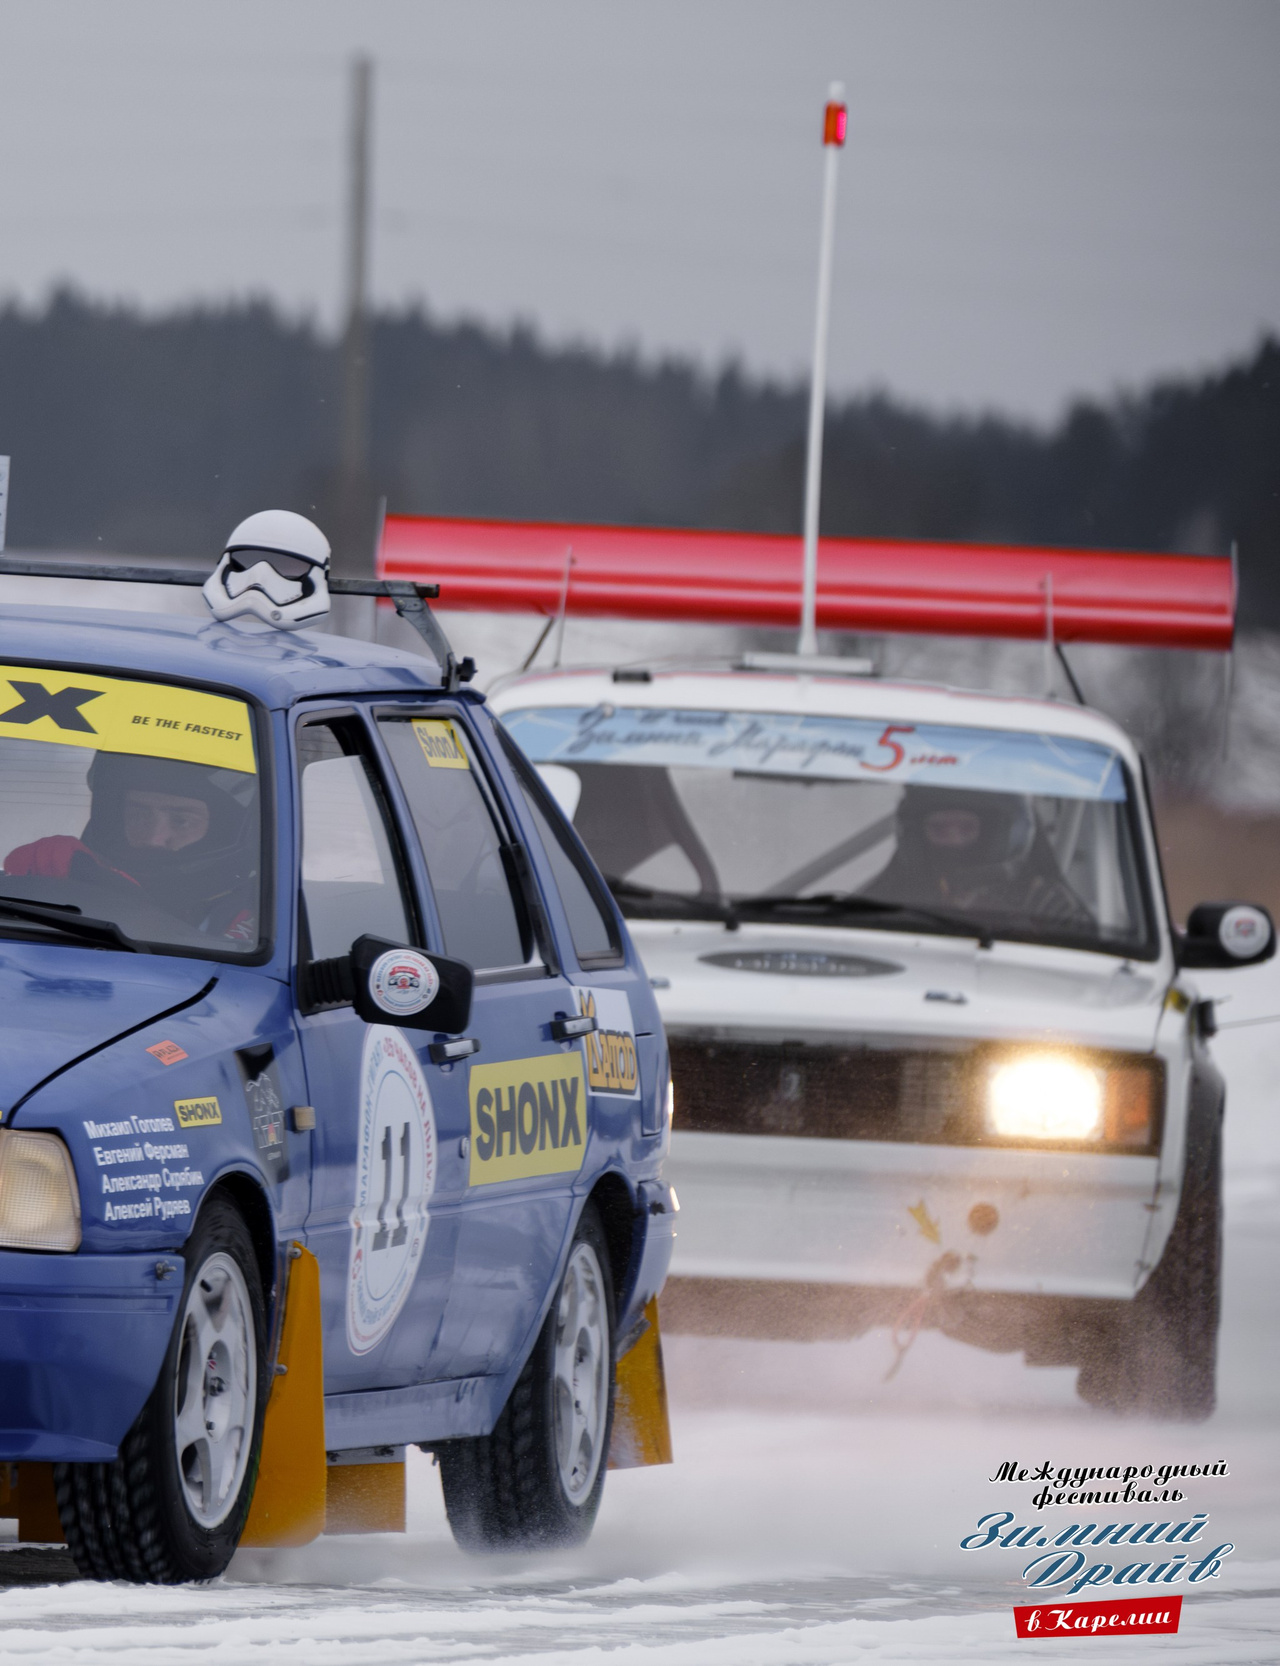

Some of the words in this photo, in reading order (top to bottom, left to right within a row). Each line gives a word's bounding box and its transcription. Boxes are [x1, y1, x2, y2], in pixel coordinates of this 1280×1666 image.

[131, 715, 151, 726] BE
[155, 717, 181, 730] THE
[184, 723, 244, 741] FASTEST
[859, 725, 916, 772] 5
[178, 1101, 220, 1123] SHONX
[475, 1076, 582, 1161] SHONX
[83, 1120, 134, 1139] Михаил
[93, 1142, 144, 1166] Евгений
[102, 1174, 162, 1194] Александр
[372, 1122, 411, 1252] 11
[104, 1198, 153, 1221] Алексей
